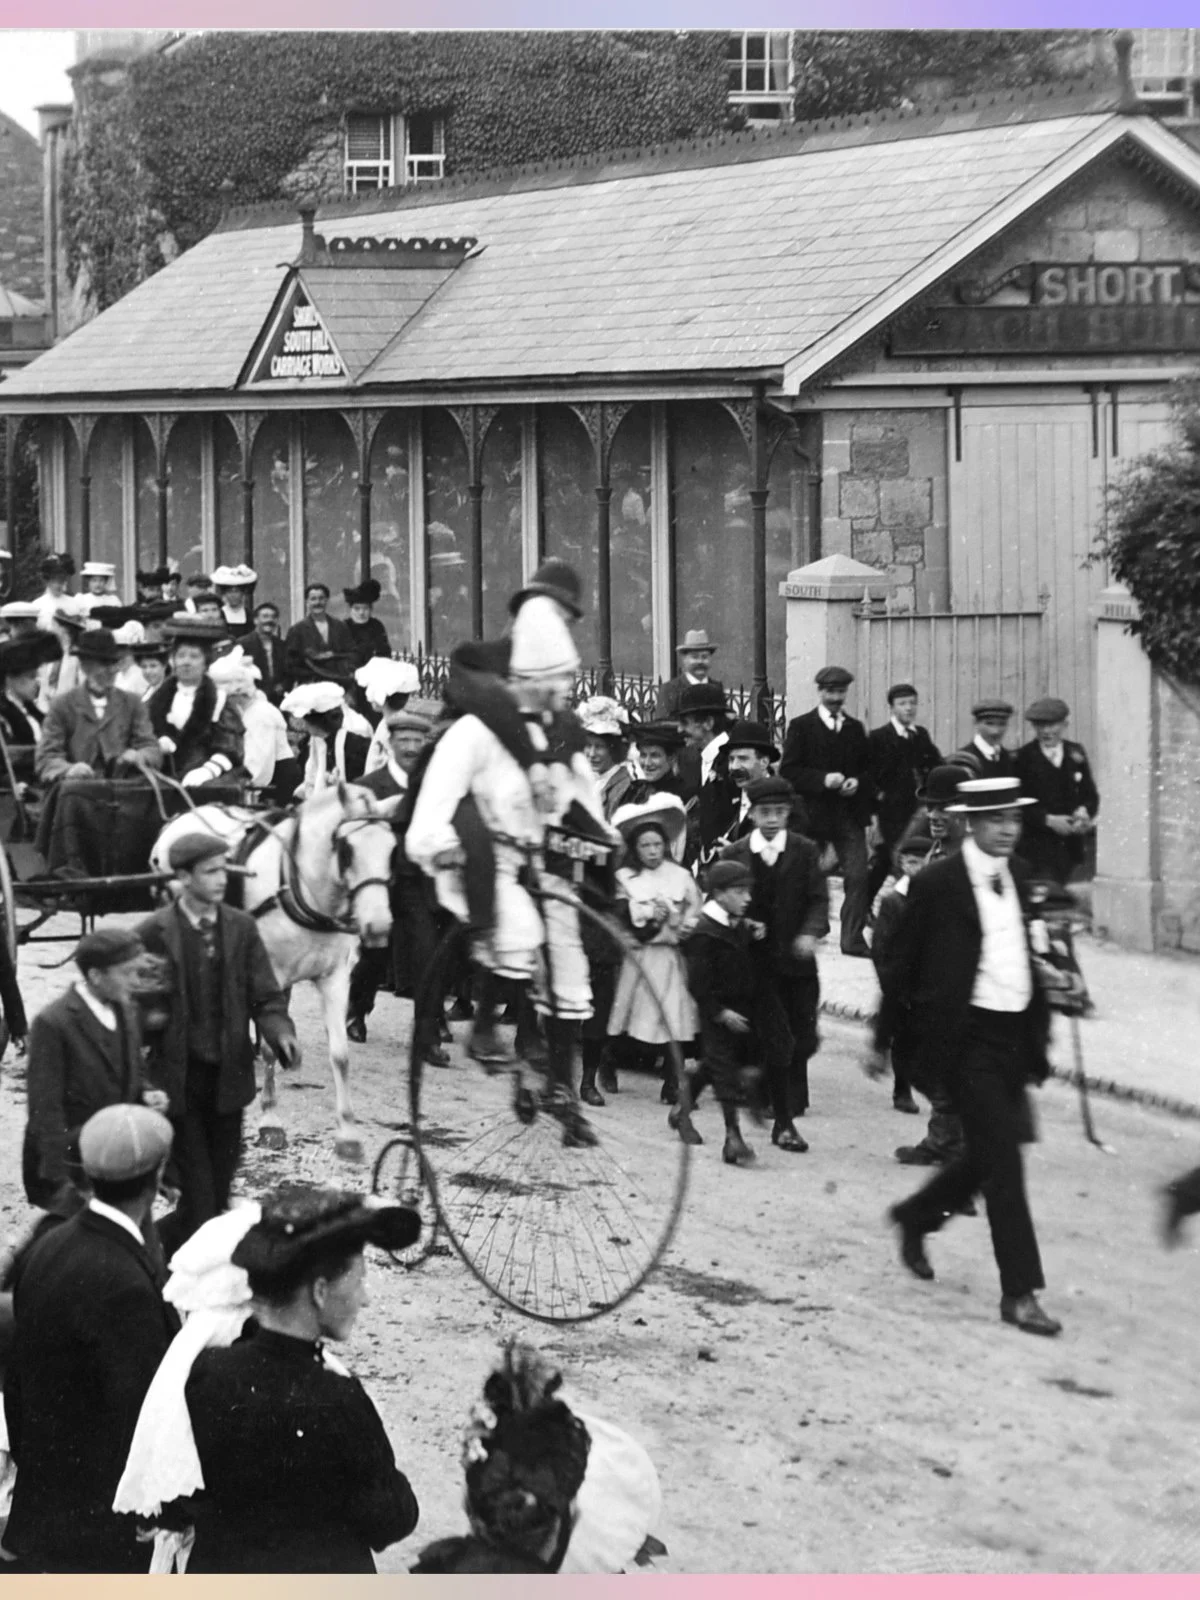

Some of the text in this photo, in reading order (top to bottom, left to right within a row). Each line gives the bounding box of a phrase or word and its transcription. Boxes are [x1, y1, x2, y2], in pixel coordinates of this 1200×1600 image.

[284, 330, 330, 351] SOUTH HILL
[271, 354, 341, 376] CARRIAGE WORKS
[784, 584, 822, 597] SOUTH
[1104, 603, 1135, 618] HILL
